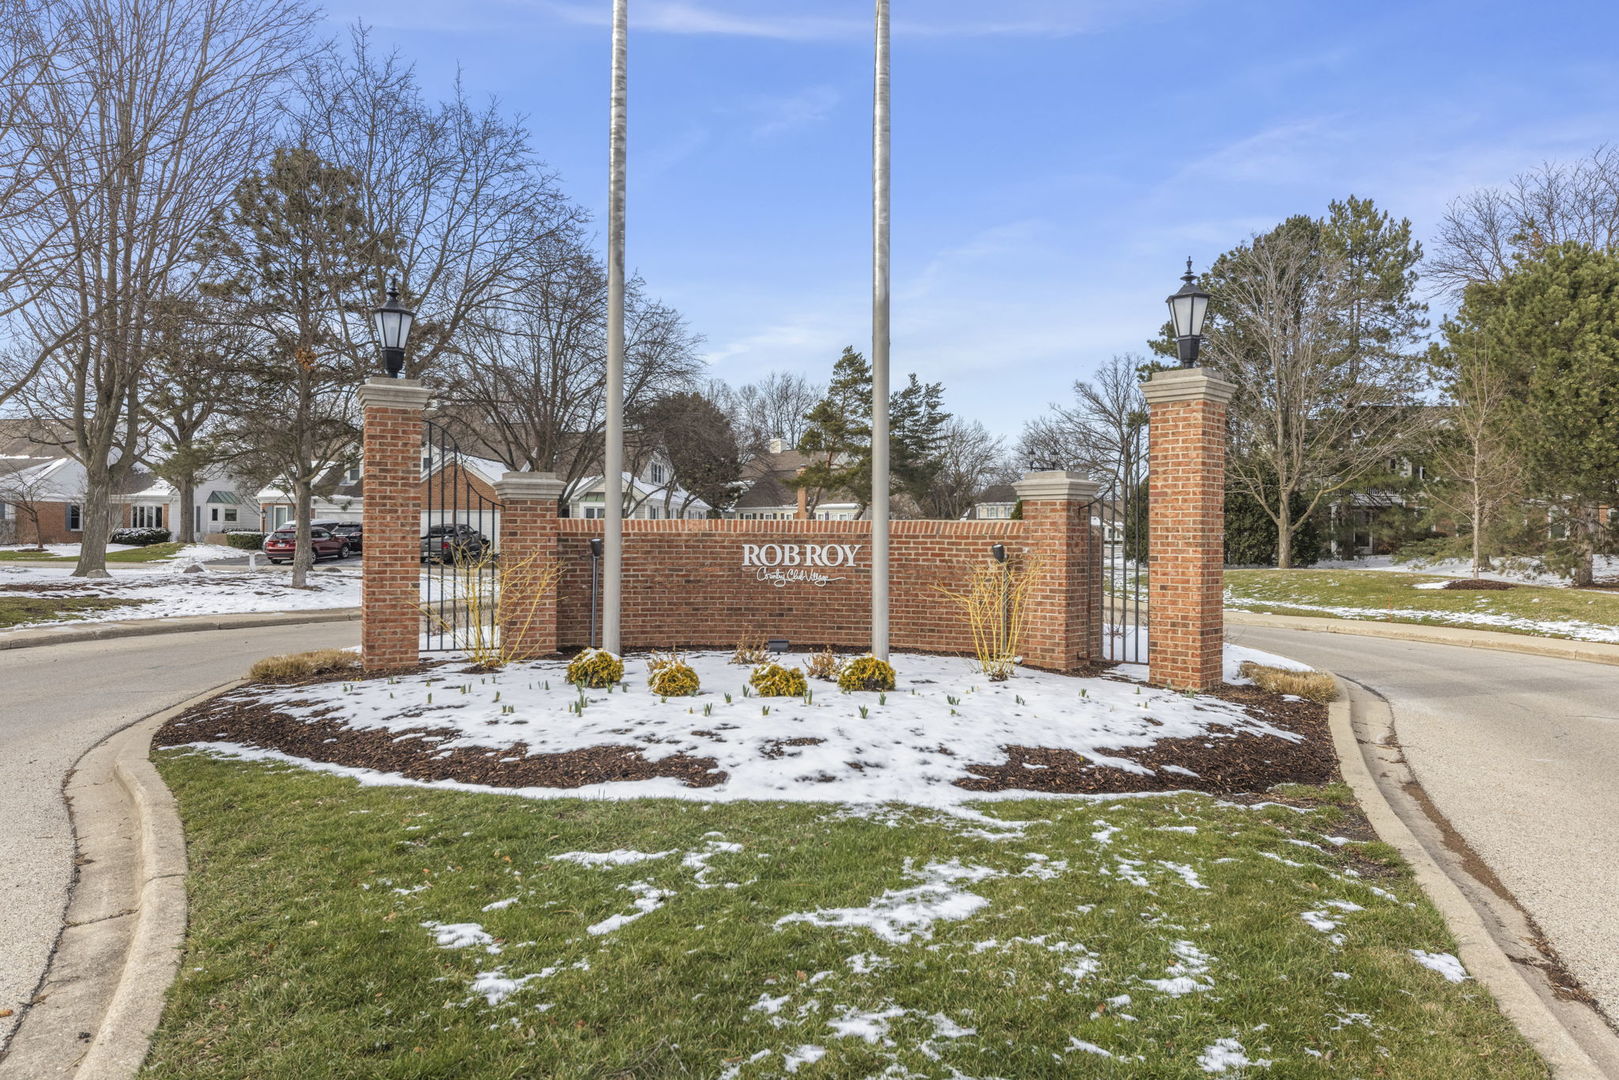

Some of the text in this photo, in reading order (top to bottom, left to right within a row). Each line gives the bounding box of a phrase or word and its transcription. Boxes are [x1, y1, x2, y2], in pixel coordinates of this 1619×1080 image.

[742, 544, 862, 566] ROB ROY
[756, 566, 786, 587] Country
[786, 568, 806, 582] Club
